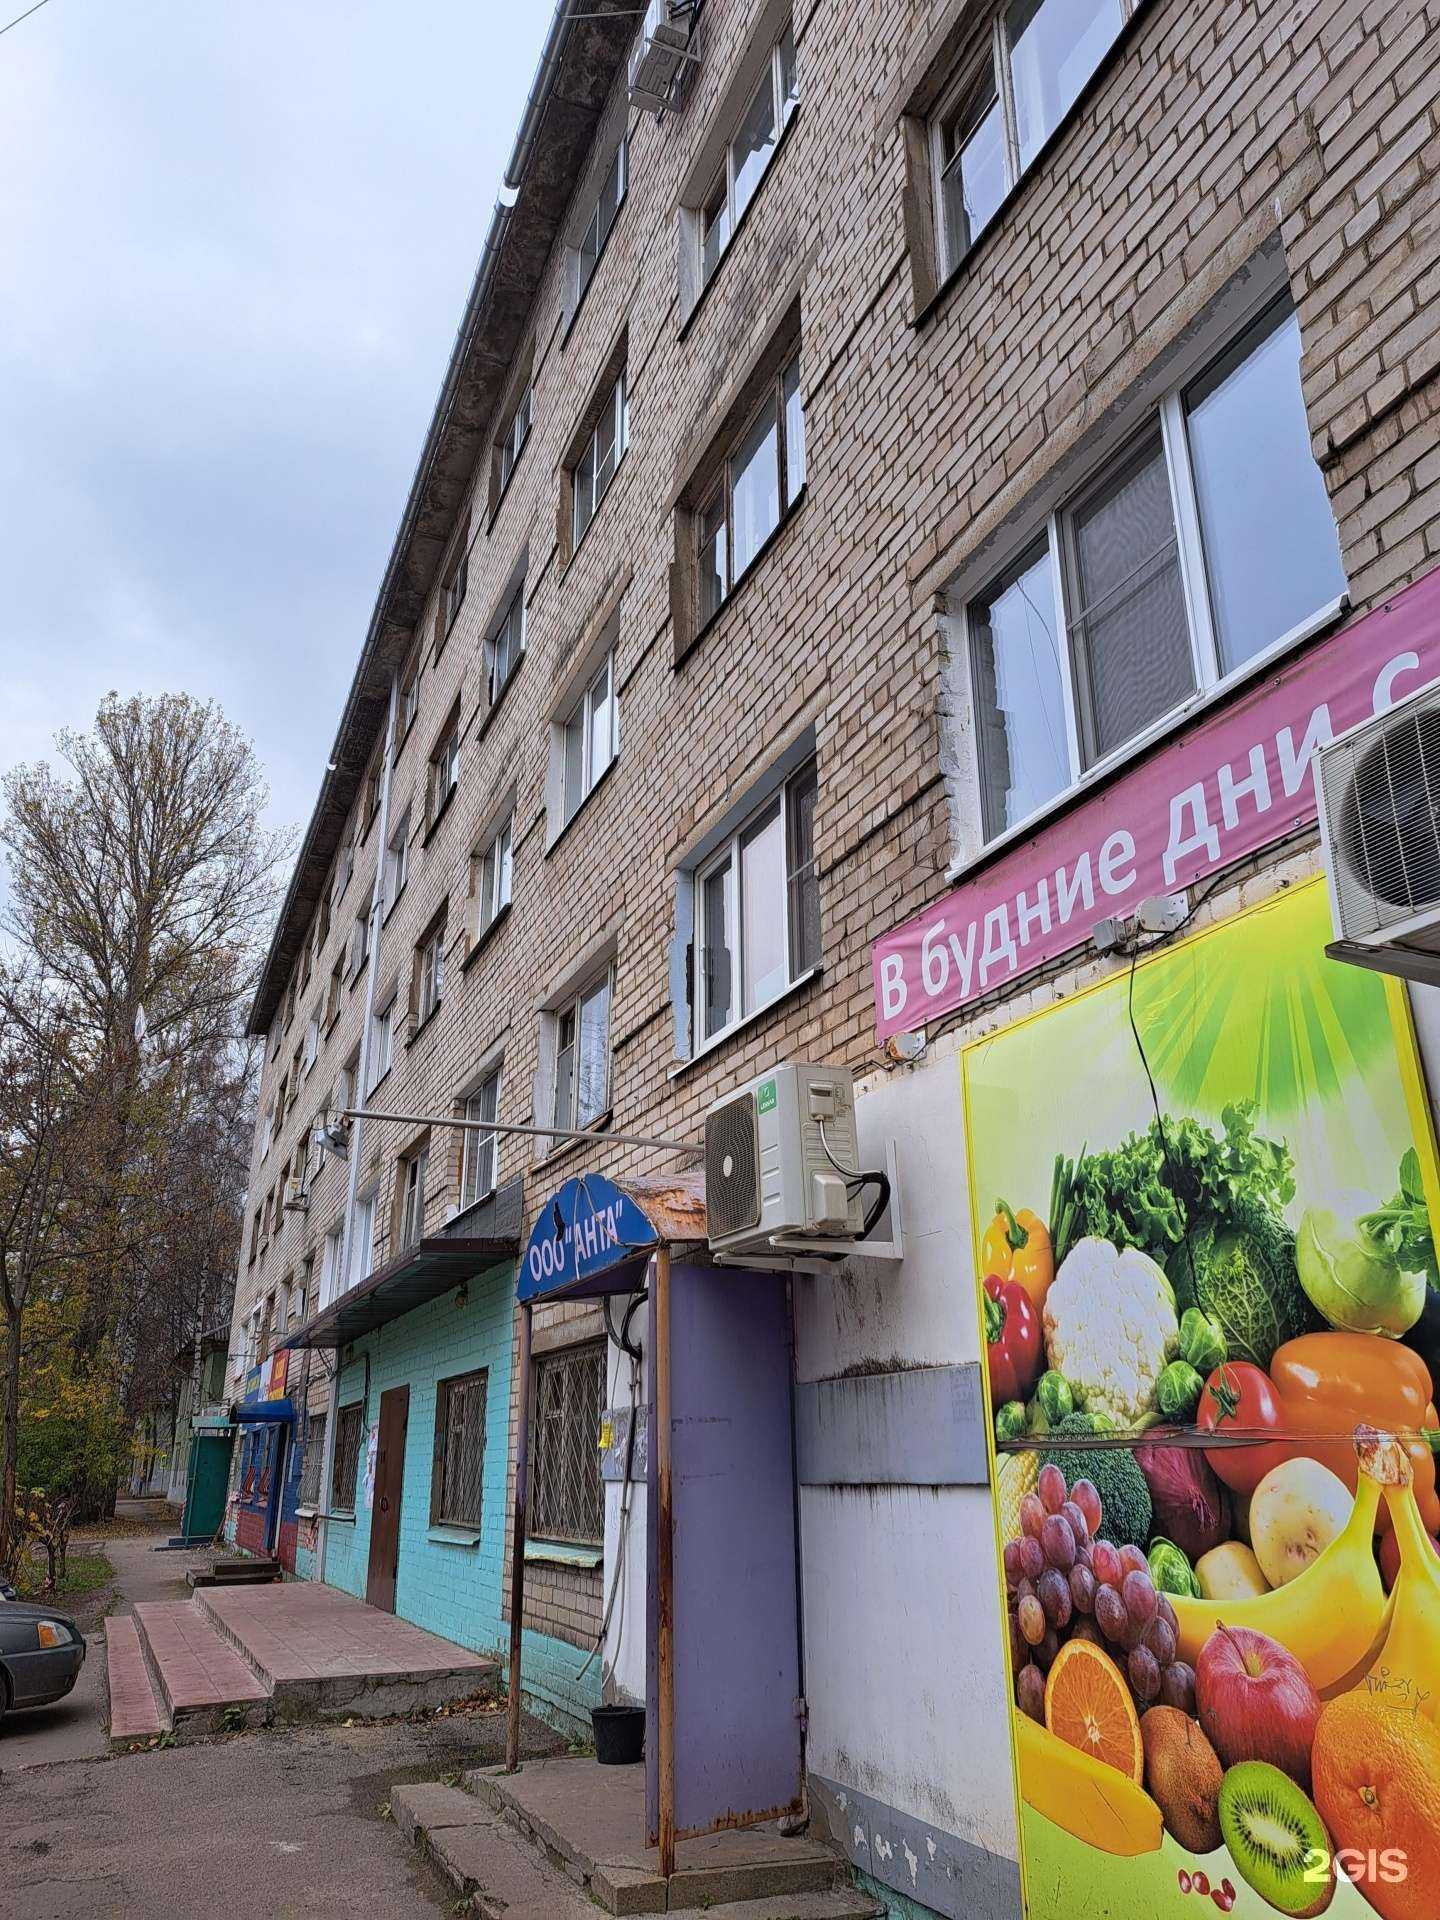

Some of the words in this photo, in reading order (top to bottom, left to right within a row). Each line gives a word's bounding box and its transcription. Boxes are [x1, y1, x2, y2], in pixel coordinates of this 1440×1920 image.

[881, 953, 907, 1020] В
[921, 830, 1136, 998] будние
[1162, 703, 1334, 886] дни
[529, 1237, 565, 1281] ООО
[565, 1199, 623, 1264] "АНТА"
